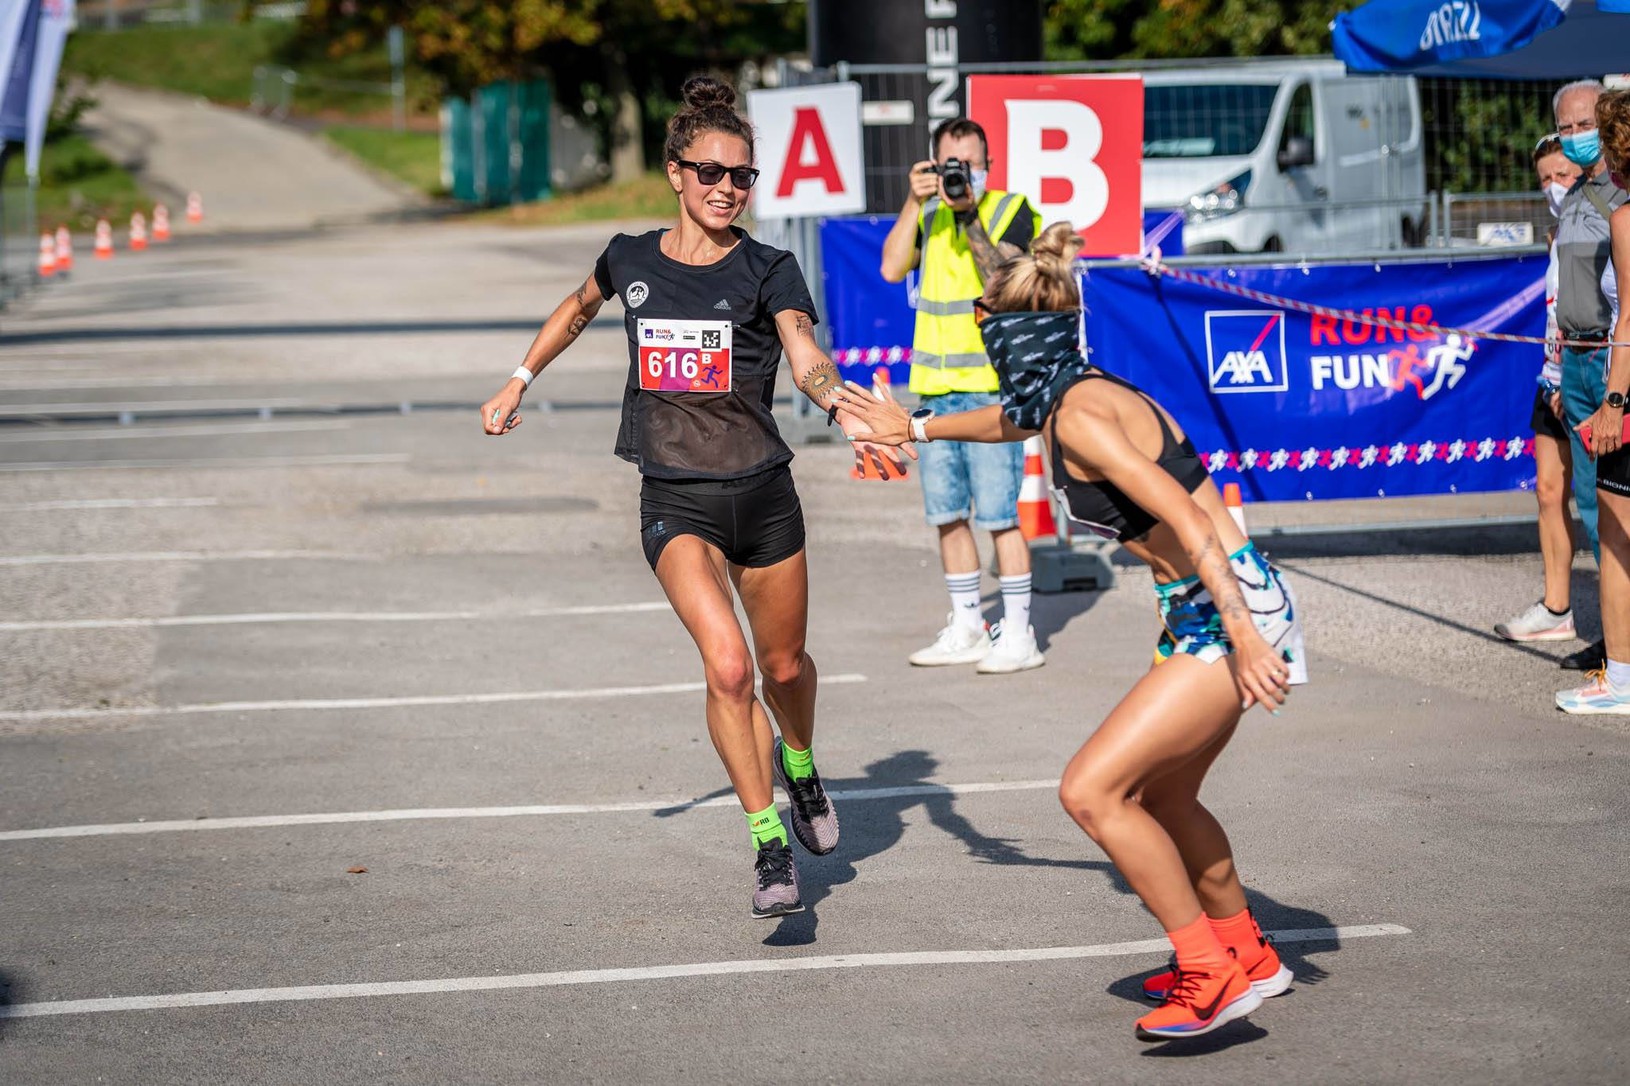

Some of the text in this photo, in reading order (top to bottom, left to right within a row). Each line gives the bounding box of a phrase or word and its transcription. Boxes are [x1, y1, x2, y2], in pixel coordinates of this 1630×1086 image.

[776, 106, 845, 197] A
[1004, 99, 1109, 231] B
[648, 352, 698, 379] 616
[702, 353, 712, 364] B
[1211, 351, 1272, 384] AXA
[1311, 354, 1391, 390] FUN
[1603, 479, 1630, 492] BIONI
